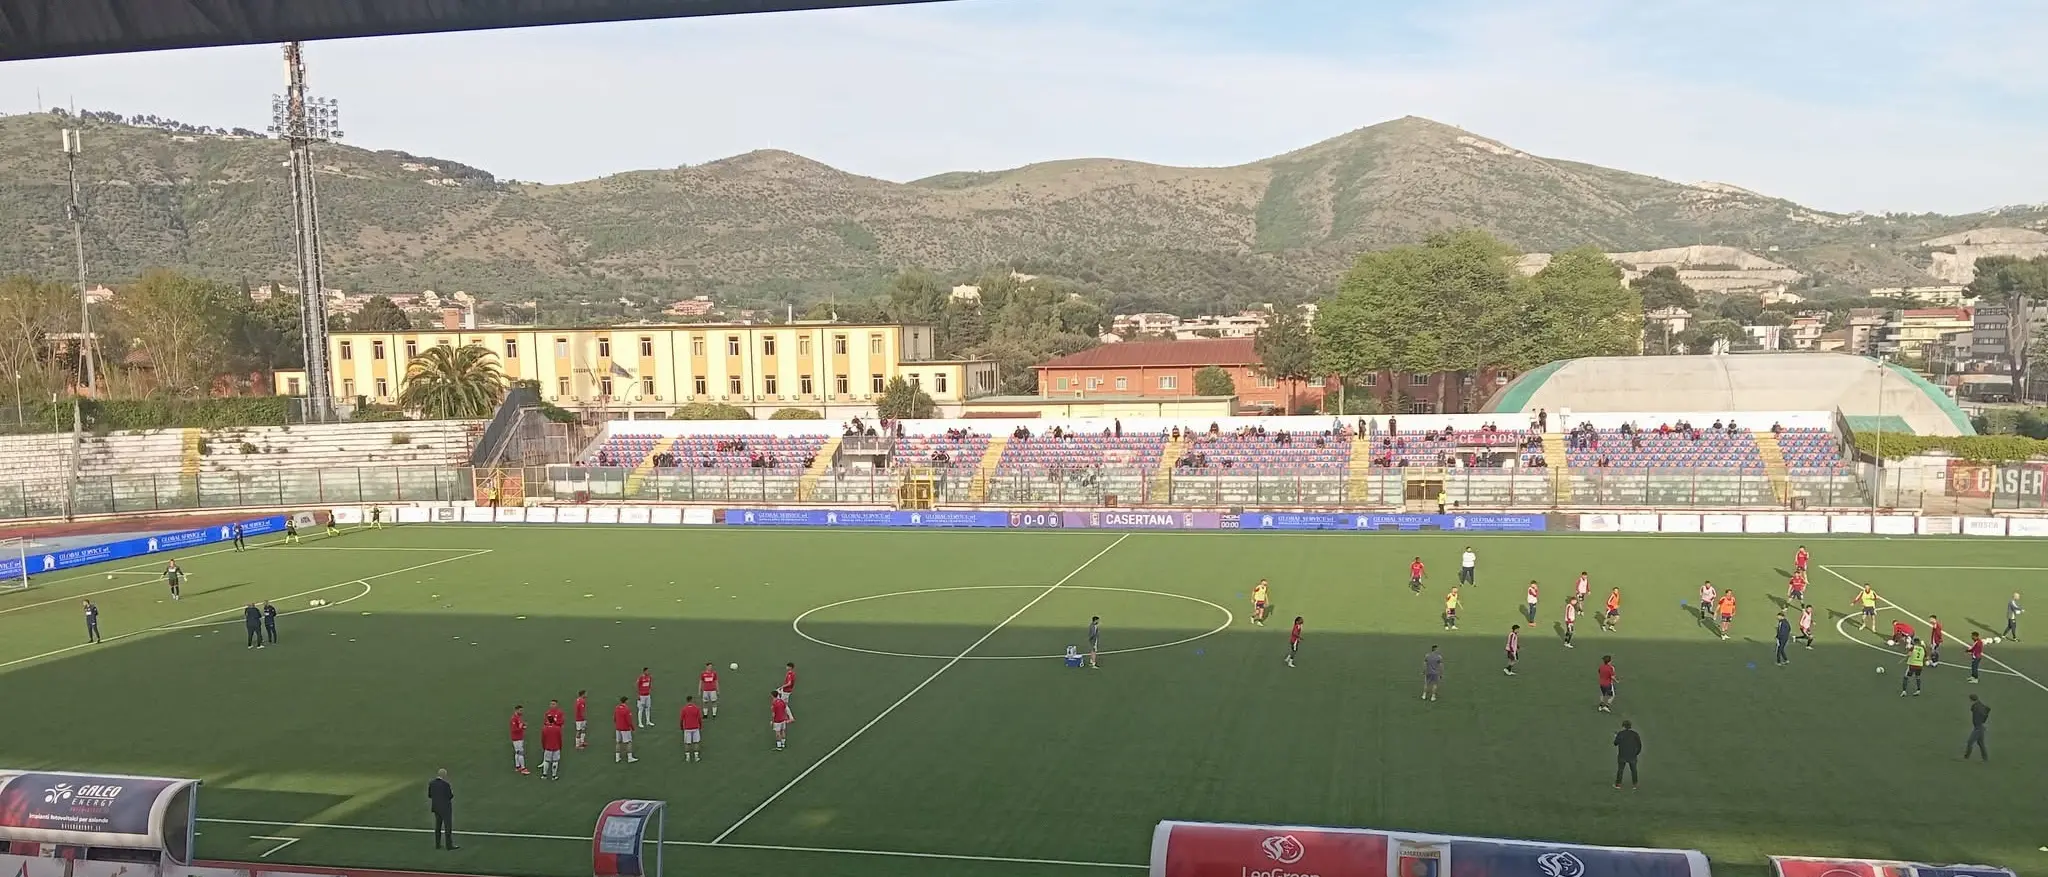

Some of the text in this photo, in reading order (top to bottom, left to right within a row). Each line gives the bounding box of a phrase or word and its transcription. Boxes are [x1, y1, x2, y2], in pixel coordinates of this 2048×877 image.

[1481, 433, 1516, 445] 1908
[1024, 514, 1045, 525] 0-0
[1106, 514, 1174, 525] CASERTANA
[161, 534, 180, 544] GLOBAL
[181, 532, 200, 541] SERVICE
[77, 784, 123, 798] GALEO
[72, 798, 114, 808] ENERGY
